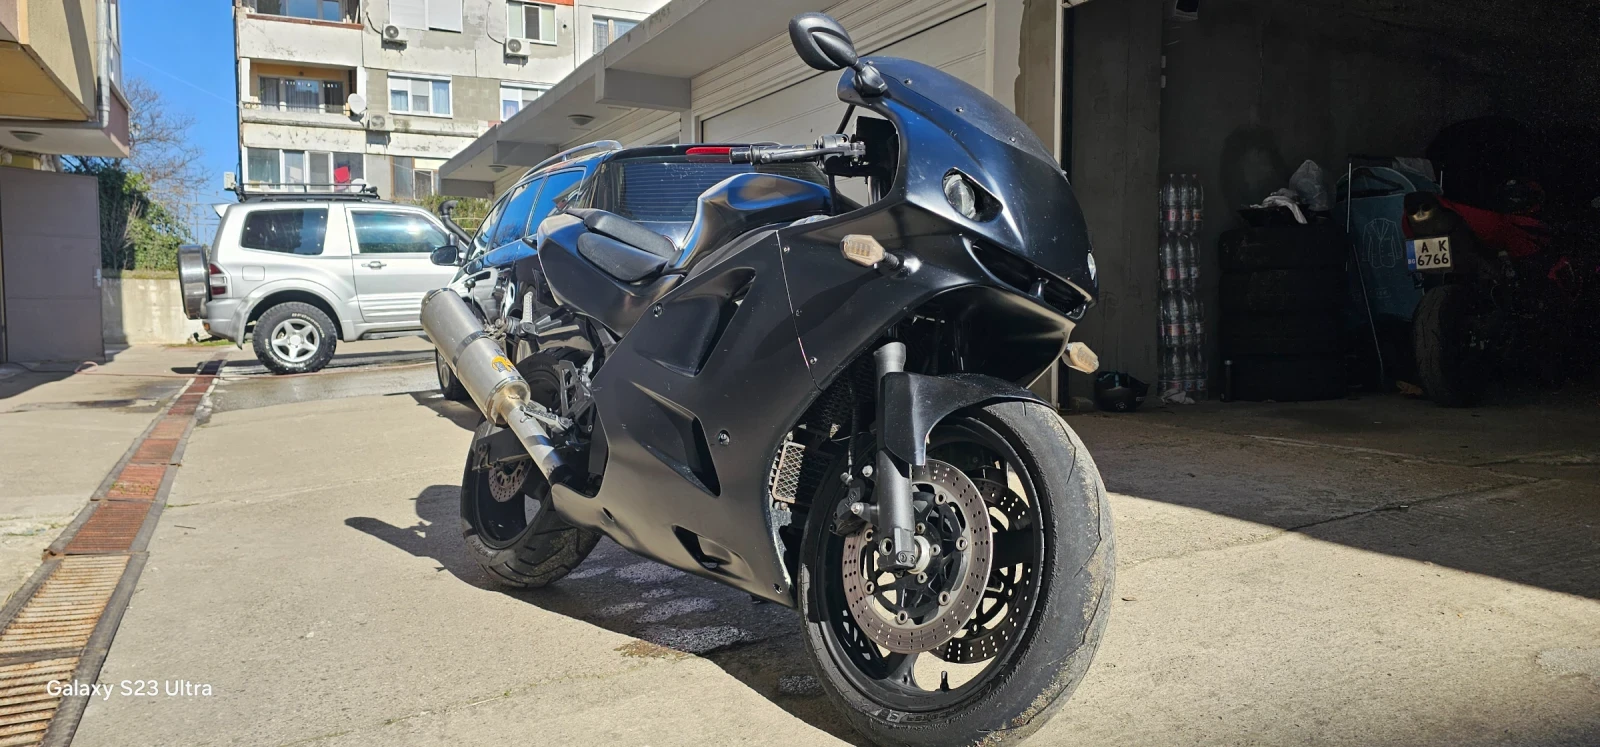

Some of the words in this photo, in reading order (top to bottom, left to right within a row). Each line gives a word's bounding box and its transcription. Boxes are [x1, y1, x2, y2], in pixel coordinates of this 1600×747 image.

[1421, 242, 1429, 253] A
[1438, 240, 1447, 251] K
[1417, 253, 1449, 266] 6766
